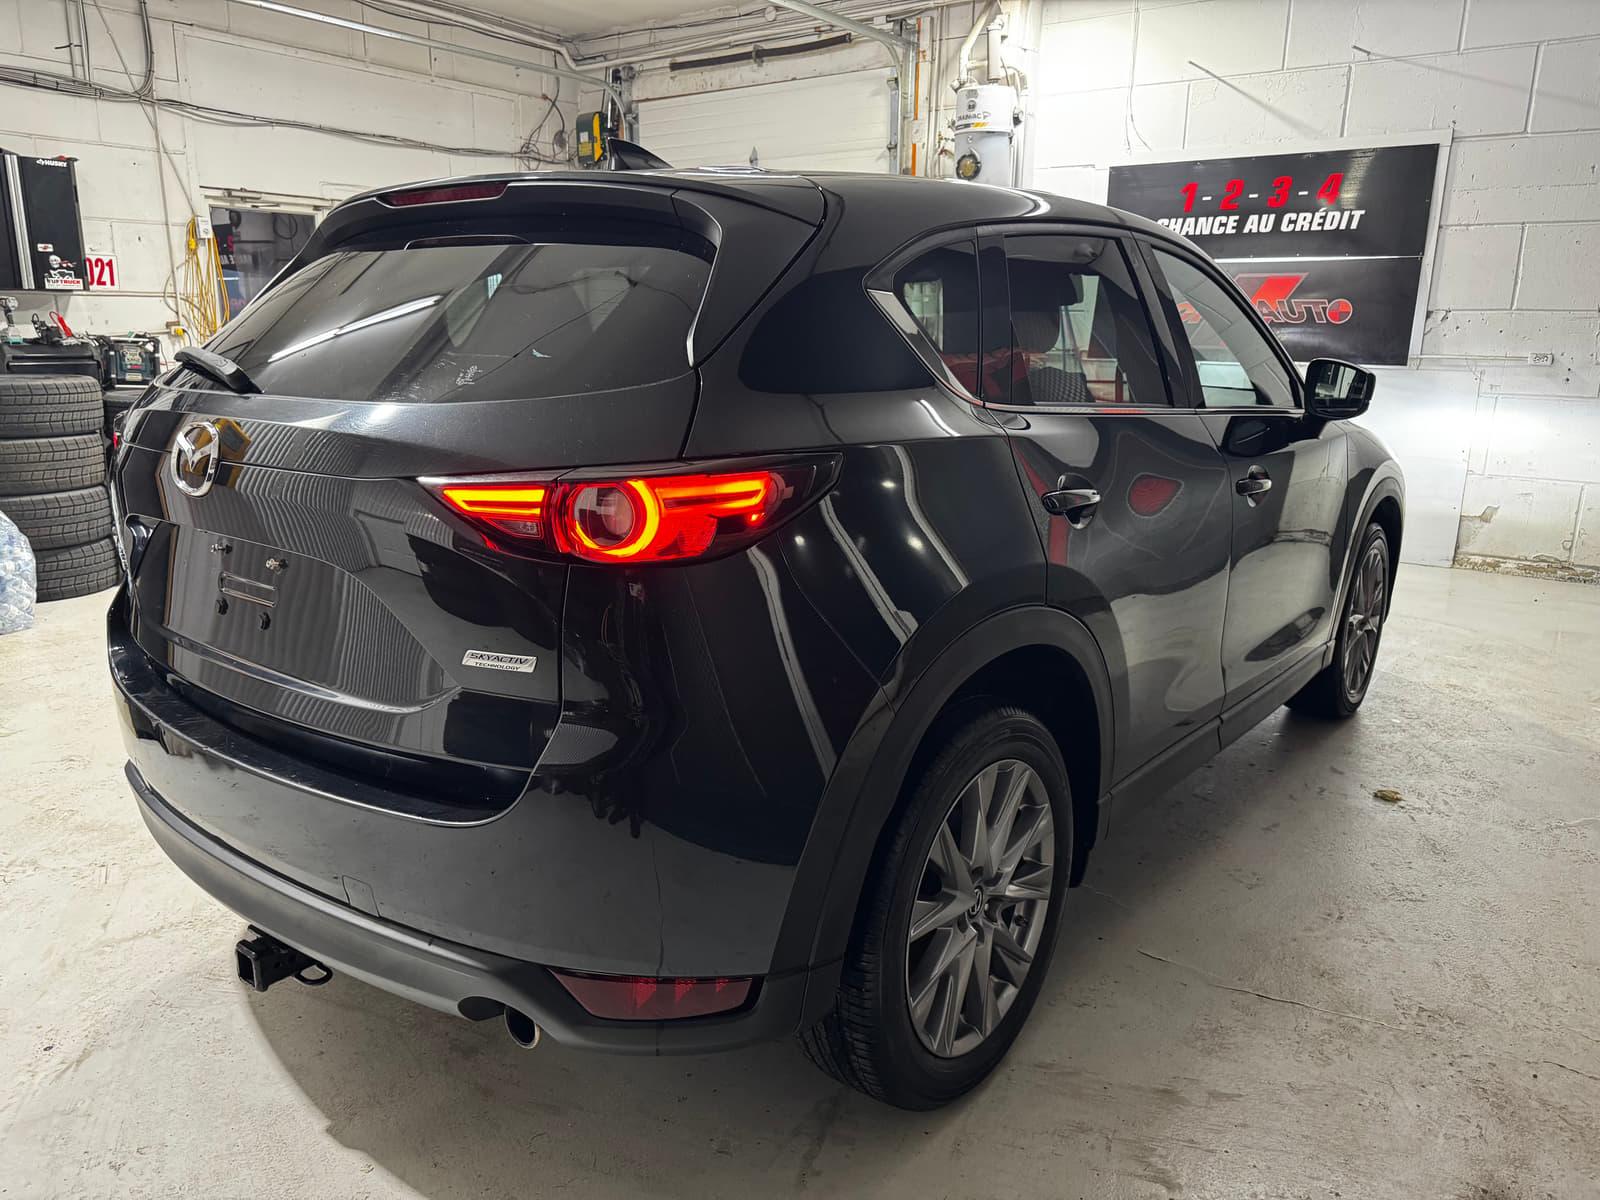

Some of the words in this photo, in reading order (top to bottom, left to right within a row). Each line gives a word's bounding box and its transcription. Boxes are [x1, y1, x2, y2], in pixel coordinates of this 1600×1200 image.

[1243, 212, 1276, 234] AU
[1280, 207, 1366, 232] CRÉDIT
[469, 652, 529, 665] SKYACTIV
[474, 661, 521, 671] TECHNOLOGY
